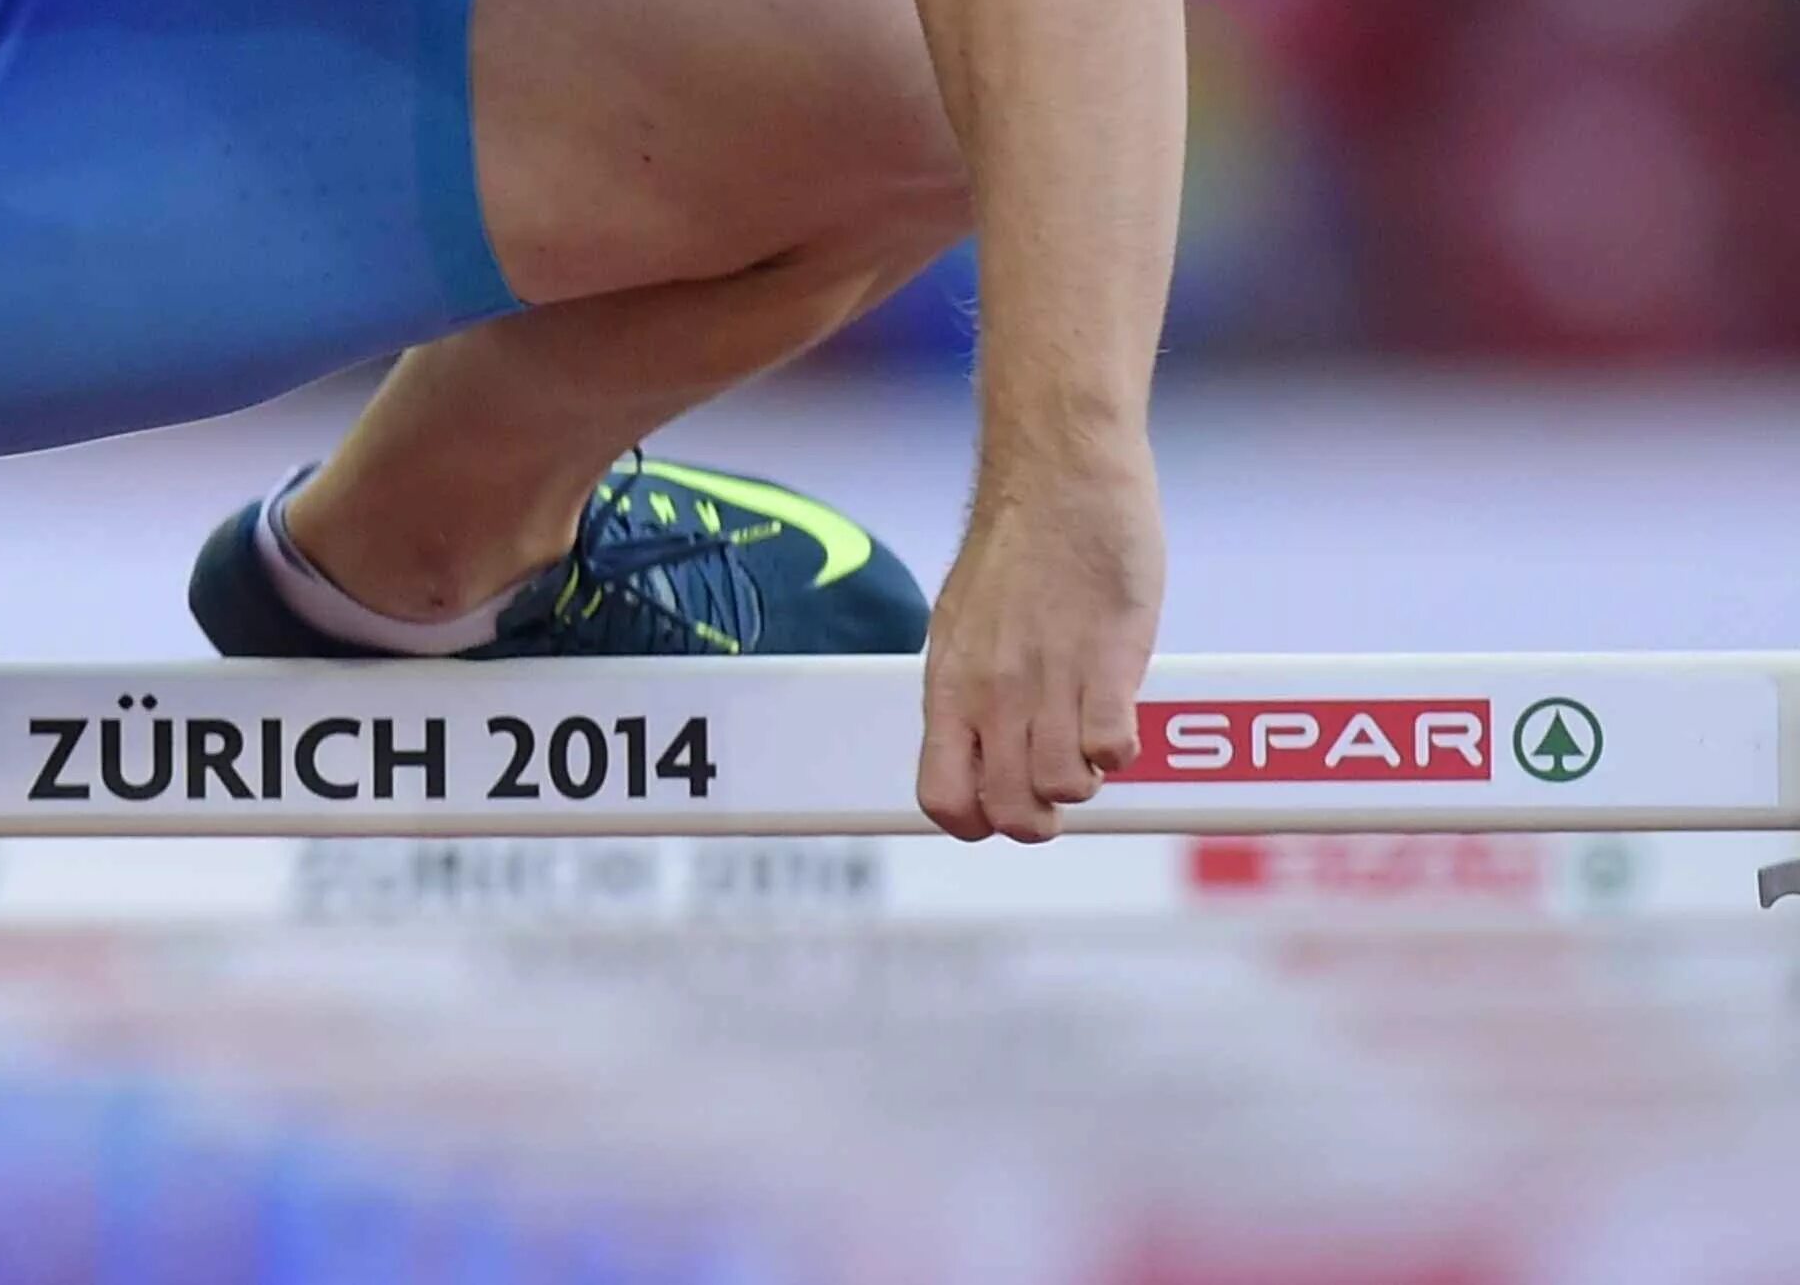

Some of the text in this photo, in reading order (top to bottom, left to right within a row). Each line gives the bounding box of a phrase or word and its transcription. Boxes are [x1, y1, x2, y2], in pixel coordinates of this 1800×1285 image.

[28, 693, 718, 802] ZÜRICH 2014
[1165, 712, 1484, 771] SPAR
